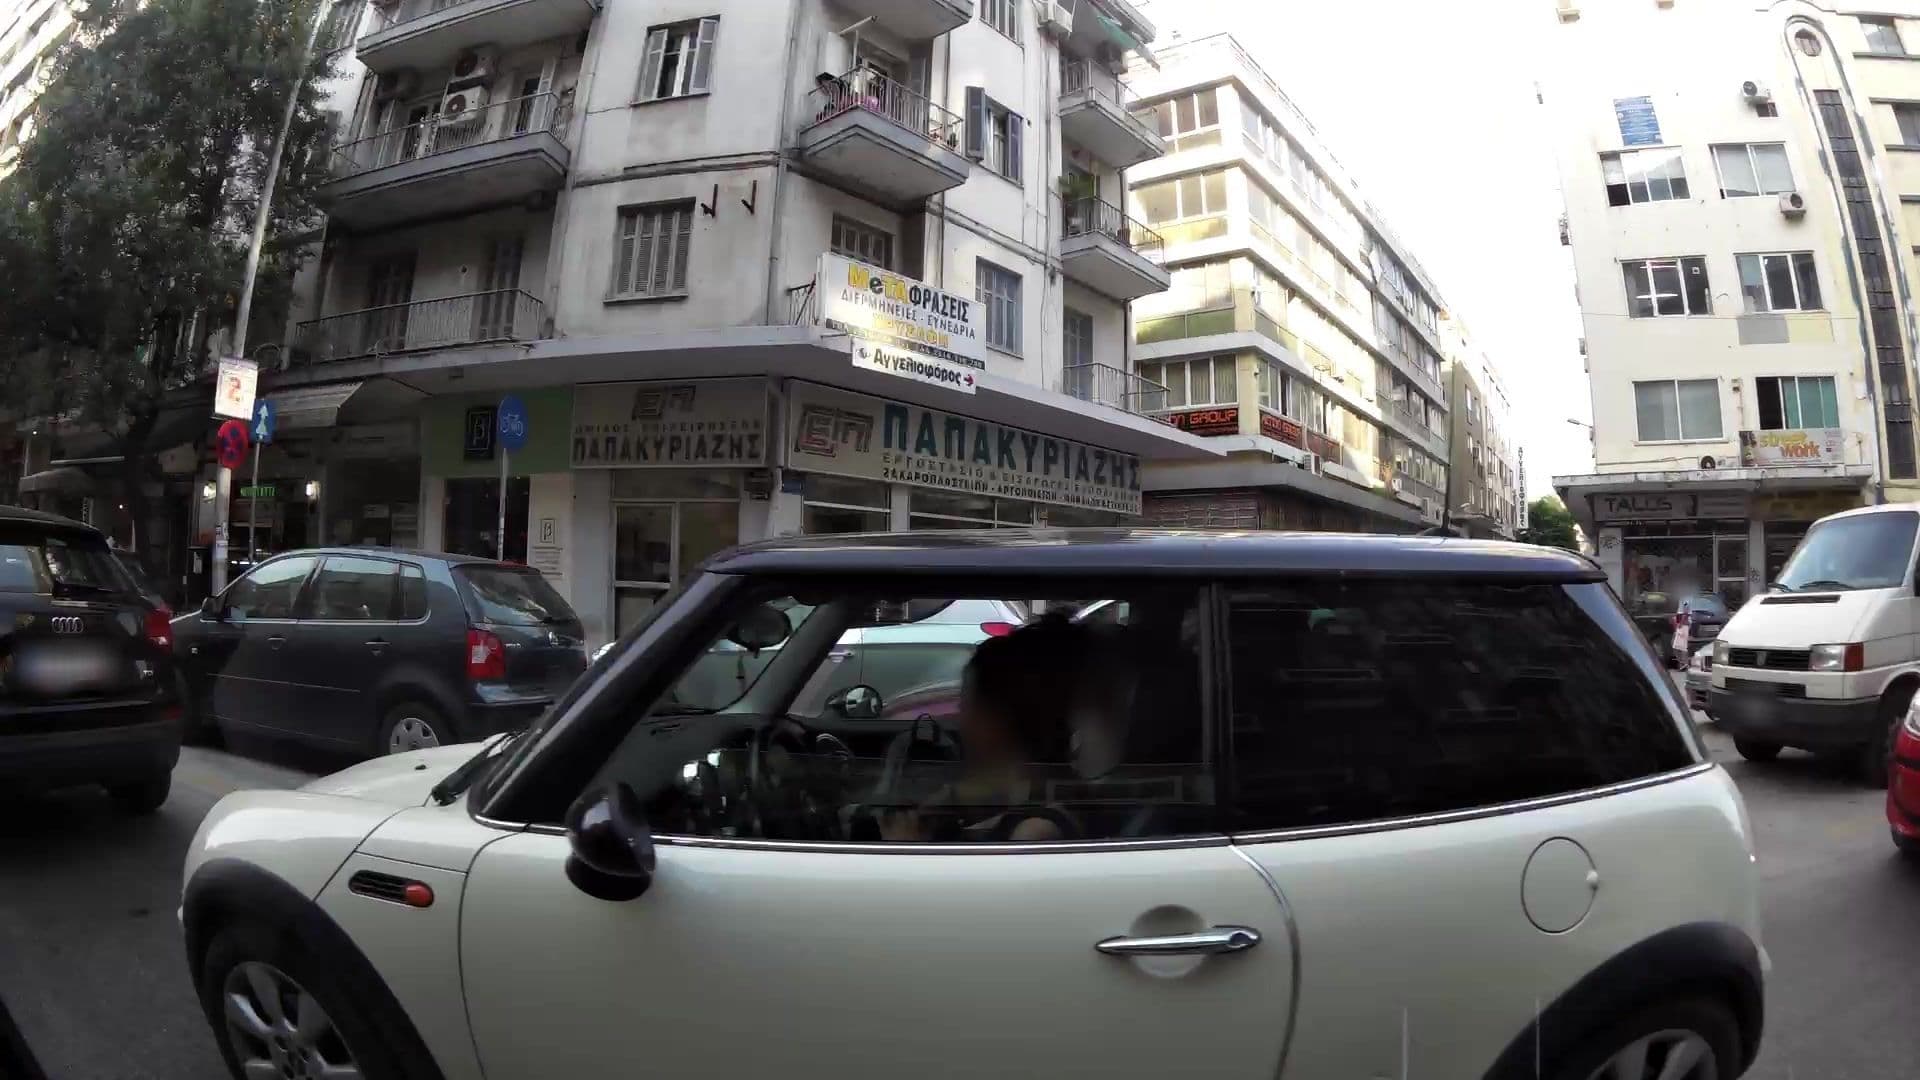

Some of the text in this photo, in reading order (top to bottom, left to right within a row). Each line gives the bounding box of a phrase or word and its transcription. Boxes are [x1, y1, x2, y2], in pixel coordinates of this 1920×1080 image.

[928, 314, 976, 340] ΣΥΝΕΔΡΙΑ
[873, 348, 962, 387] Αγγελιοφόρος
[573, 433, 761, 463] ΠΑΠΑΚΥΡΙΑΖΗΣ
[884, 402, 1141, 492] ΠΑΠΑΚΥΡΙΑΖΗΣ
